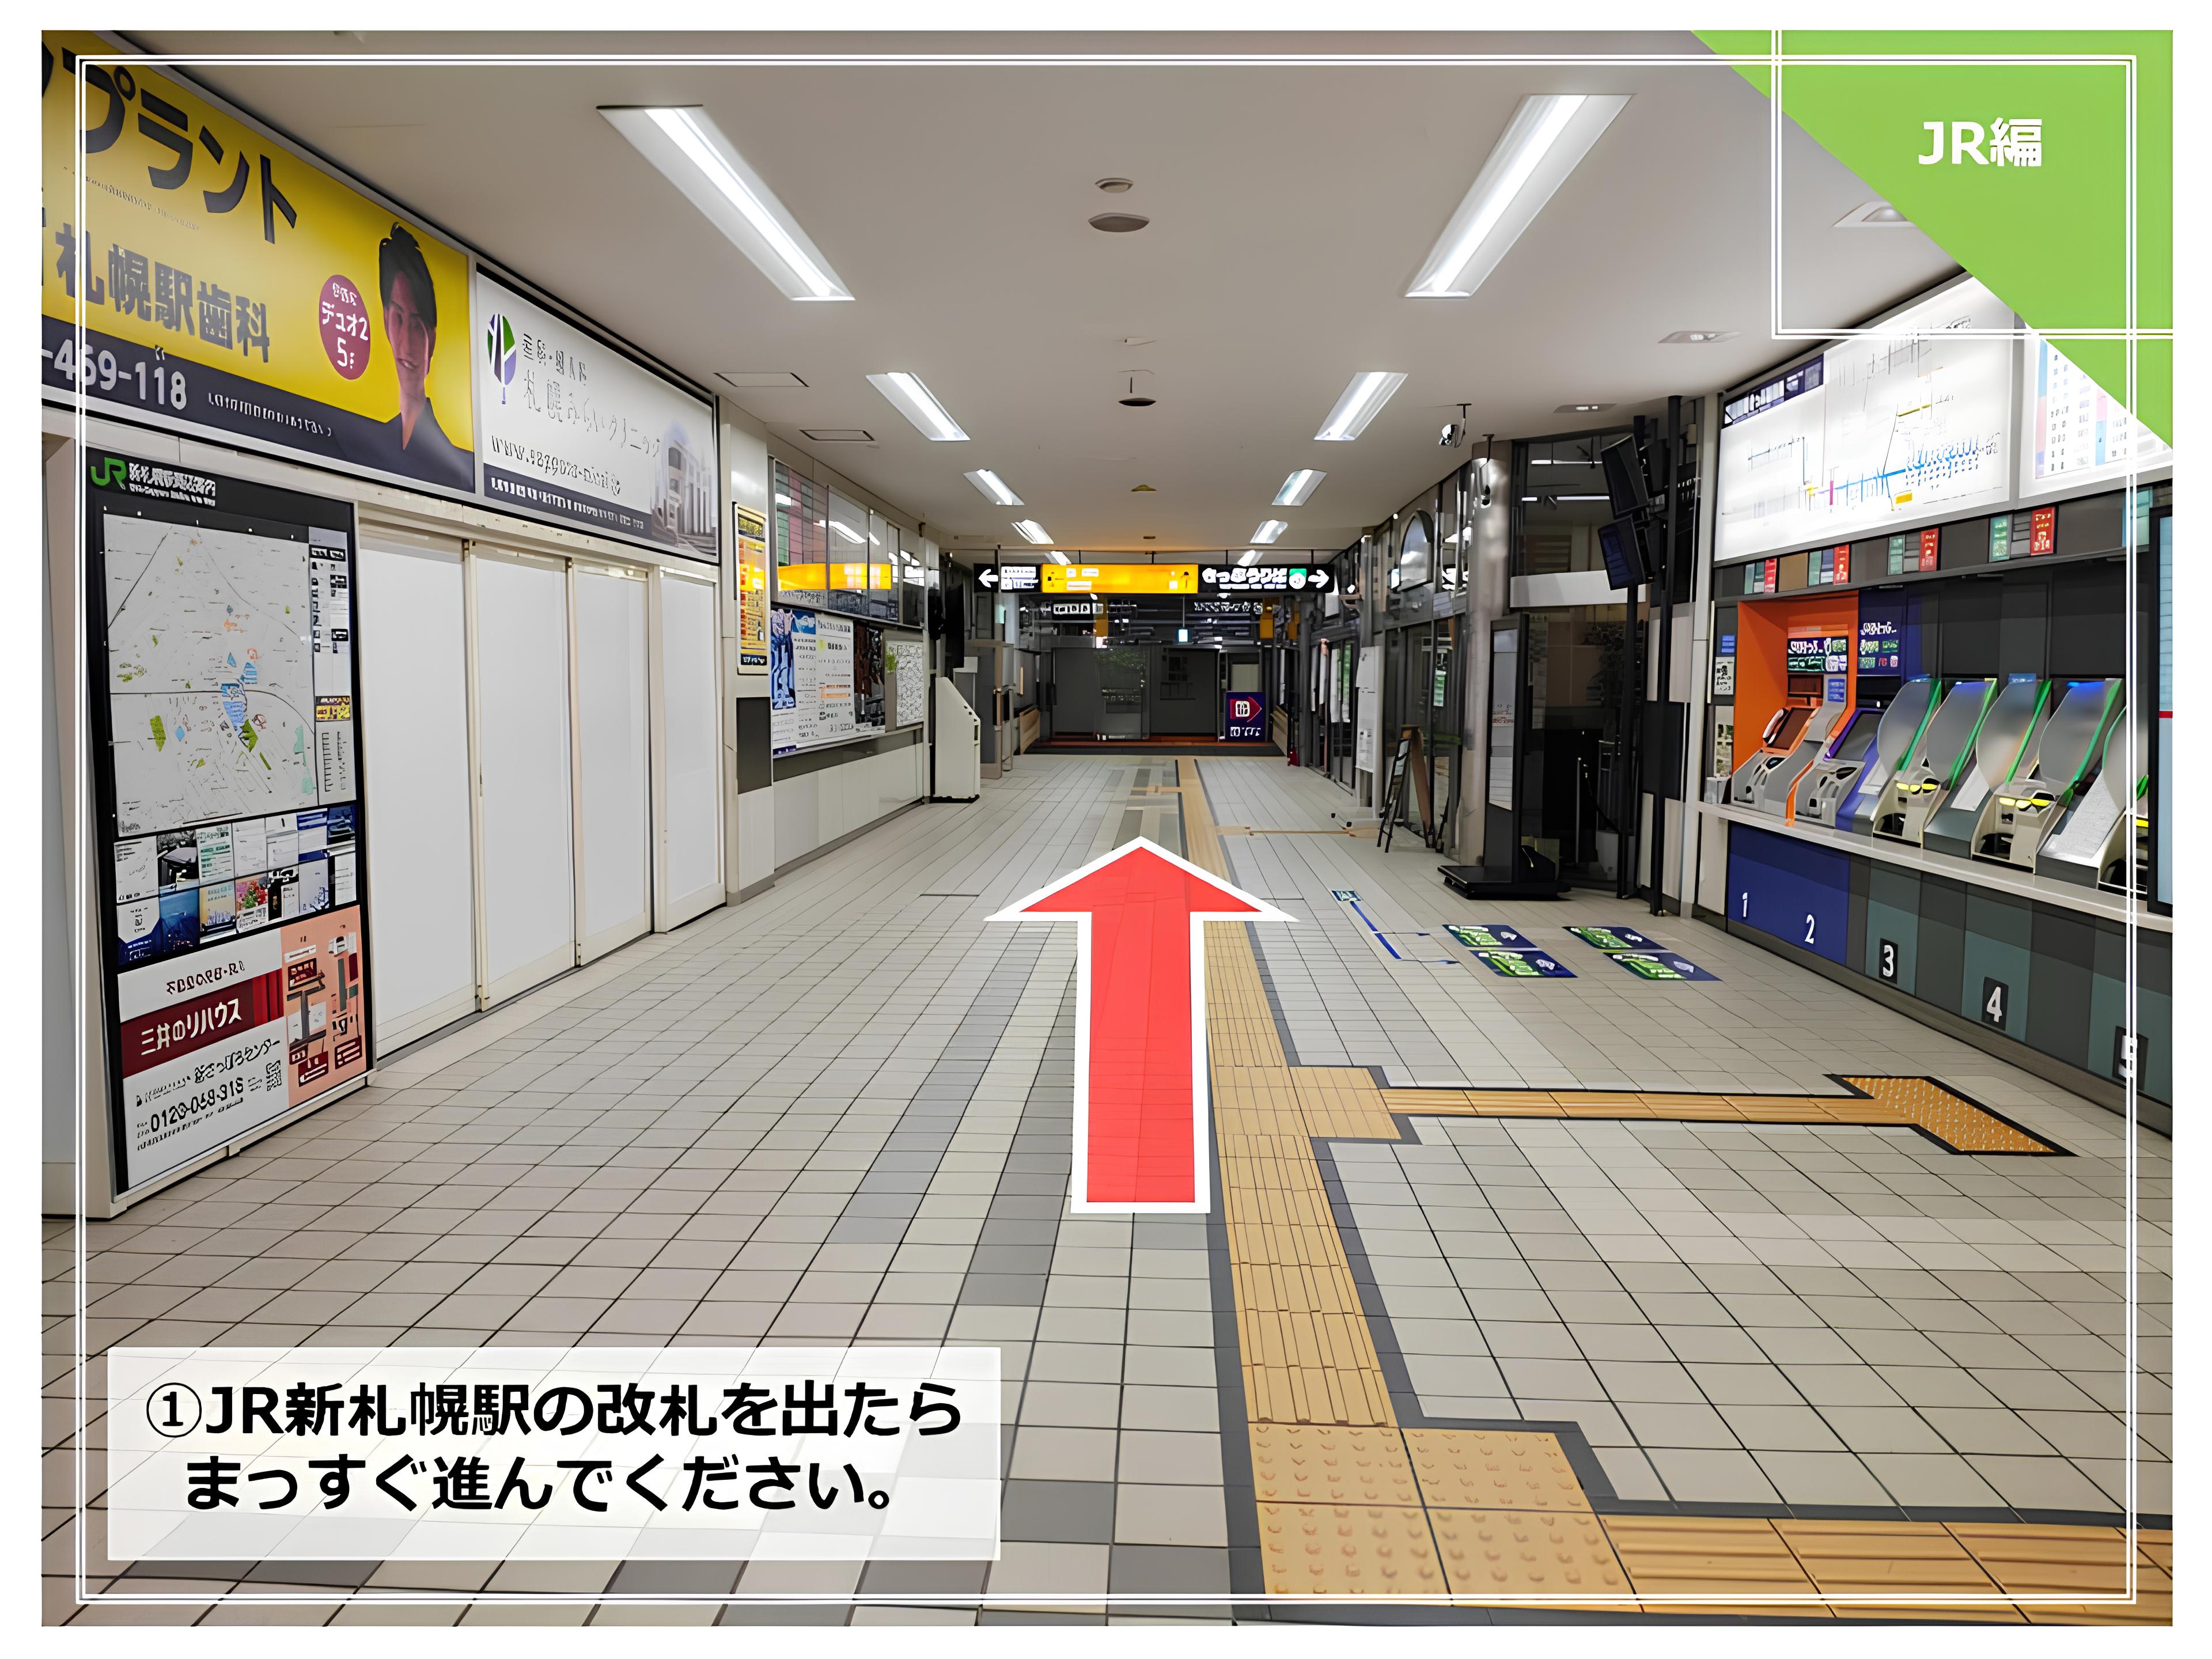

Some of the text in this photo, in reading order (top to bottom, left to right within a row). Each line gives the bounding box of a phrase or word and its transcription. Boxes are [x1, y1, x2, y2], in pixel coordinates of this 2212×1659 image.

[41, 41, 297, 244] プラント
[90, 457, 127, 490] JR
[1742, 892, 1748, 918] 1
[1804, 914, 1815, 944] 2
[1883, 944, 1894, 977] 3
[1986, 986, 2002, 1022] 4
[141, 998, 243, 1056] 三井のリハウス
